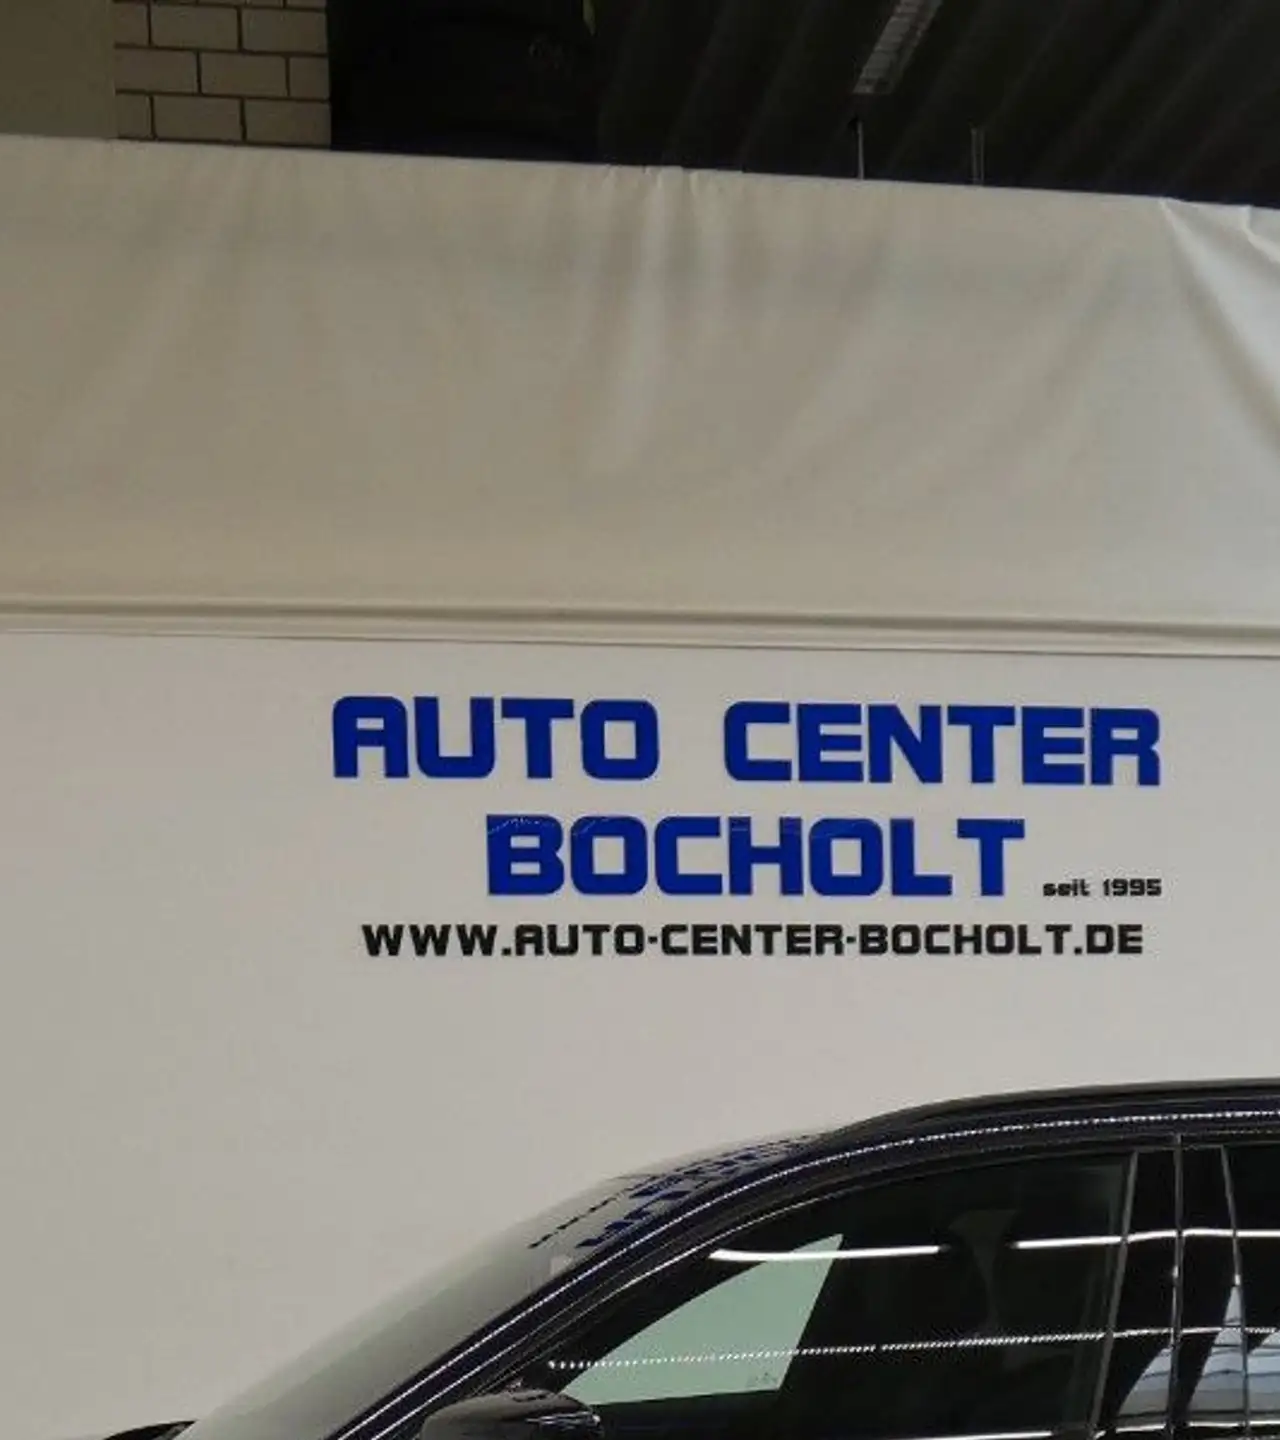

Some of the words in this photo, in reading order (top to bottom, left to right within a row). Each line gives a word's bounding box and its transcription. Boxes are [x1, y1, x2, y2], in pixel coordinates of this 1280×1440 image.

[331, 695, 660, 782] AUTO
[724, 700, 1162, 788] CENTER
[485, 813, 1026, 898] BOCHOLT
[1042, 878, 1091, 897] seit
[1102, 878, 1162, 897] 1995
[361, 922, 1144, 957] WWW.AUTO-CENTER-BOCHOLT.DE
